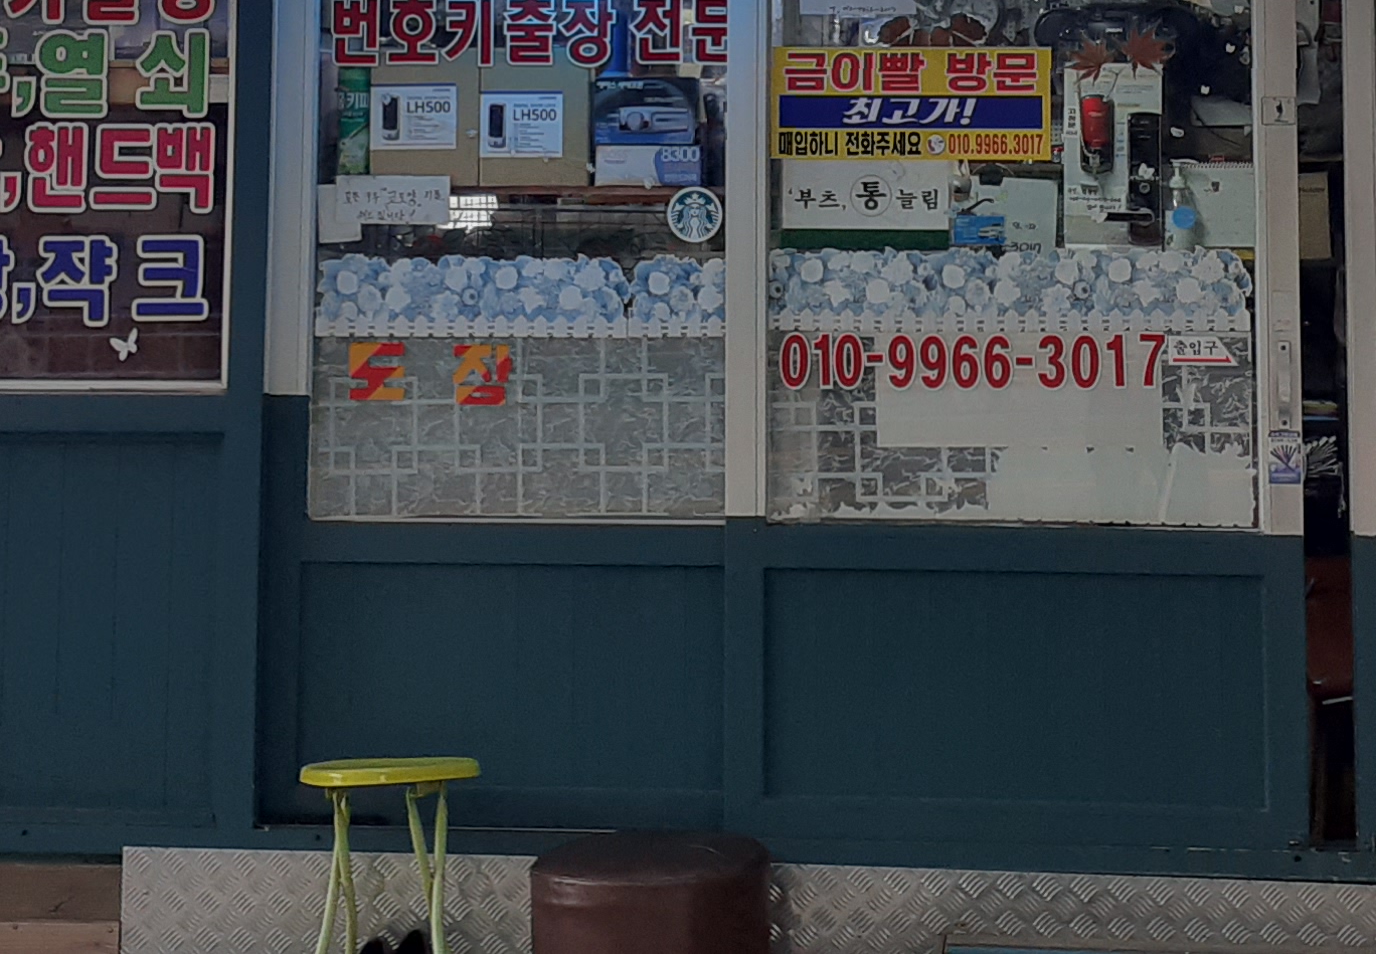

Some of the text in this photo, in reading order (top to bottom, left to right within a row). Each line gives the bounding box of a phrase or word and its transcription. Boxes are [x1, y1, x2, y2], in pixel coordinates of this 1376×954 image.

[784, 51, 1038, 92] 금이빨 방문
[406, 101, 451, 114] LH500
[513, 109, 557, 121] LH500
[842, 97, 977, 125] 최고가!
[779, 132, 1043, 156] 매입하니 전화주세요 010.9966.3017
[855, 181, 887, 210] 통
[896, 189, 938, 211] 늘림
[1173, 339, 1218, 356] 출입구
[780, 333, 1166, 389] 010-9966-3017
